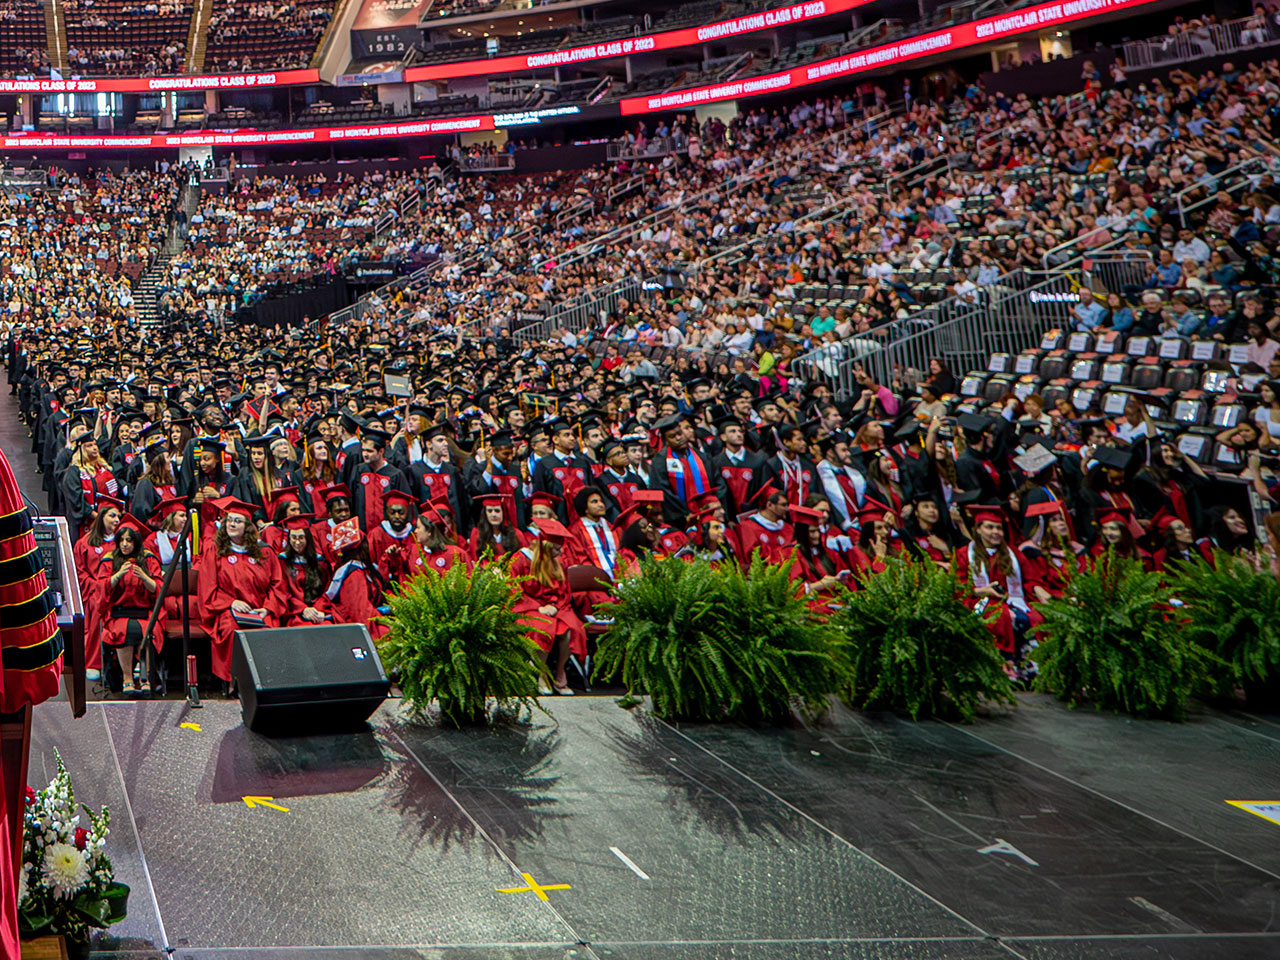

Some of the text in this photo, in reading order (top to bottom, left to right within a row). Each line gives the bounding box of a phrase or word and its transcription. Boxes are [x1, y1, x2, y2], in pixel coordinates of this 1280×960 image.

[698, 1, 824, 40] CONGRATULATIONS CLASS OF 2023
[976, 23, 994, 37] 2023
[993, 12, 1037, 32] MONTCLAIR
[1038, 5, 1062, 22] STATE
[368, 42, 405, 53] 1982
[527, 38, 654, 67] CONGRATULATIONS CLASS OF 2023
[808, 33, 950, 79] 2023 MONTCLAIR STATE UNIVERSITY COMMENCEMENT
[149, 74, 275, 89] CONGRATULATIONS CLASS OF 2023
